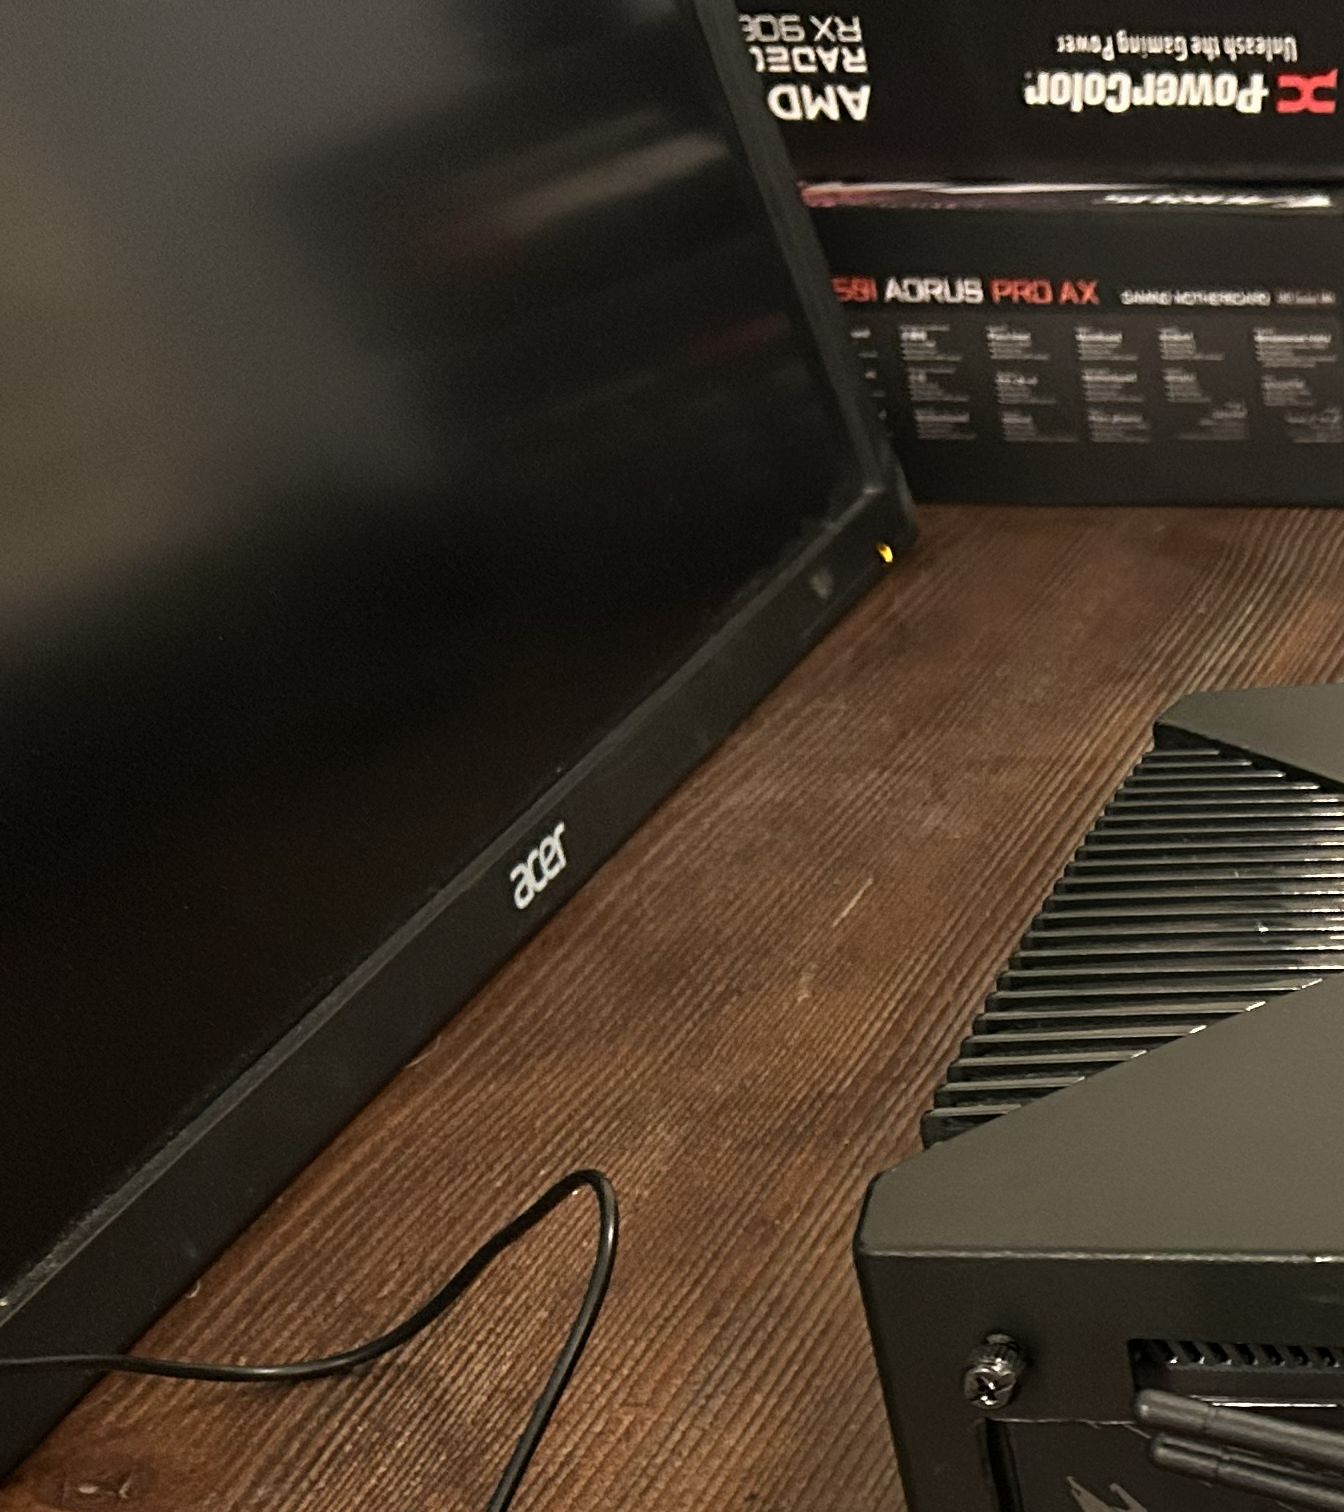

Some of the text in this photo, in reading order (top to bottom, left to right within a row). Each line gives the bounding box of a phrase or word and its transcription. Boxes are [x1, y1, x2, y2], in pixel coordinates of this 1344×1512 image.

[809, 15, 862, 42] RX
[1056, 29, 1298, 62] Unleash the Gaming Power
[767, 84, 871, 121] AMD
[1024, 69, 1270, 114] PowerColor
[884, 276, 984, 304] AORUS
[989, 278, 1053, 305] PRO
[1059, 279, 1100, 305] AX
[509, 821, 567, 910] acer
